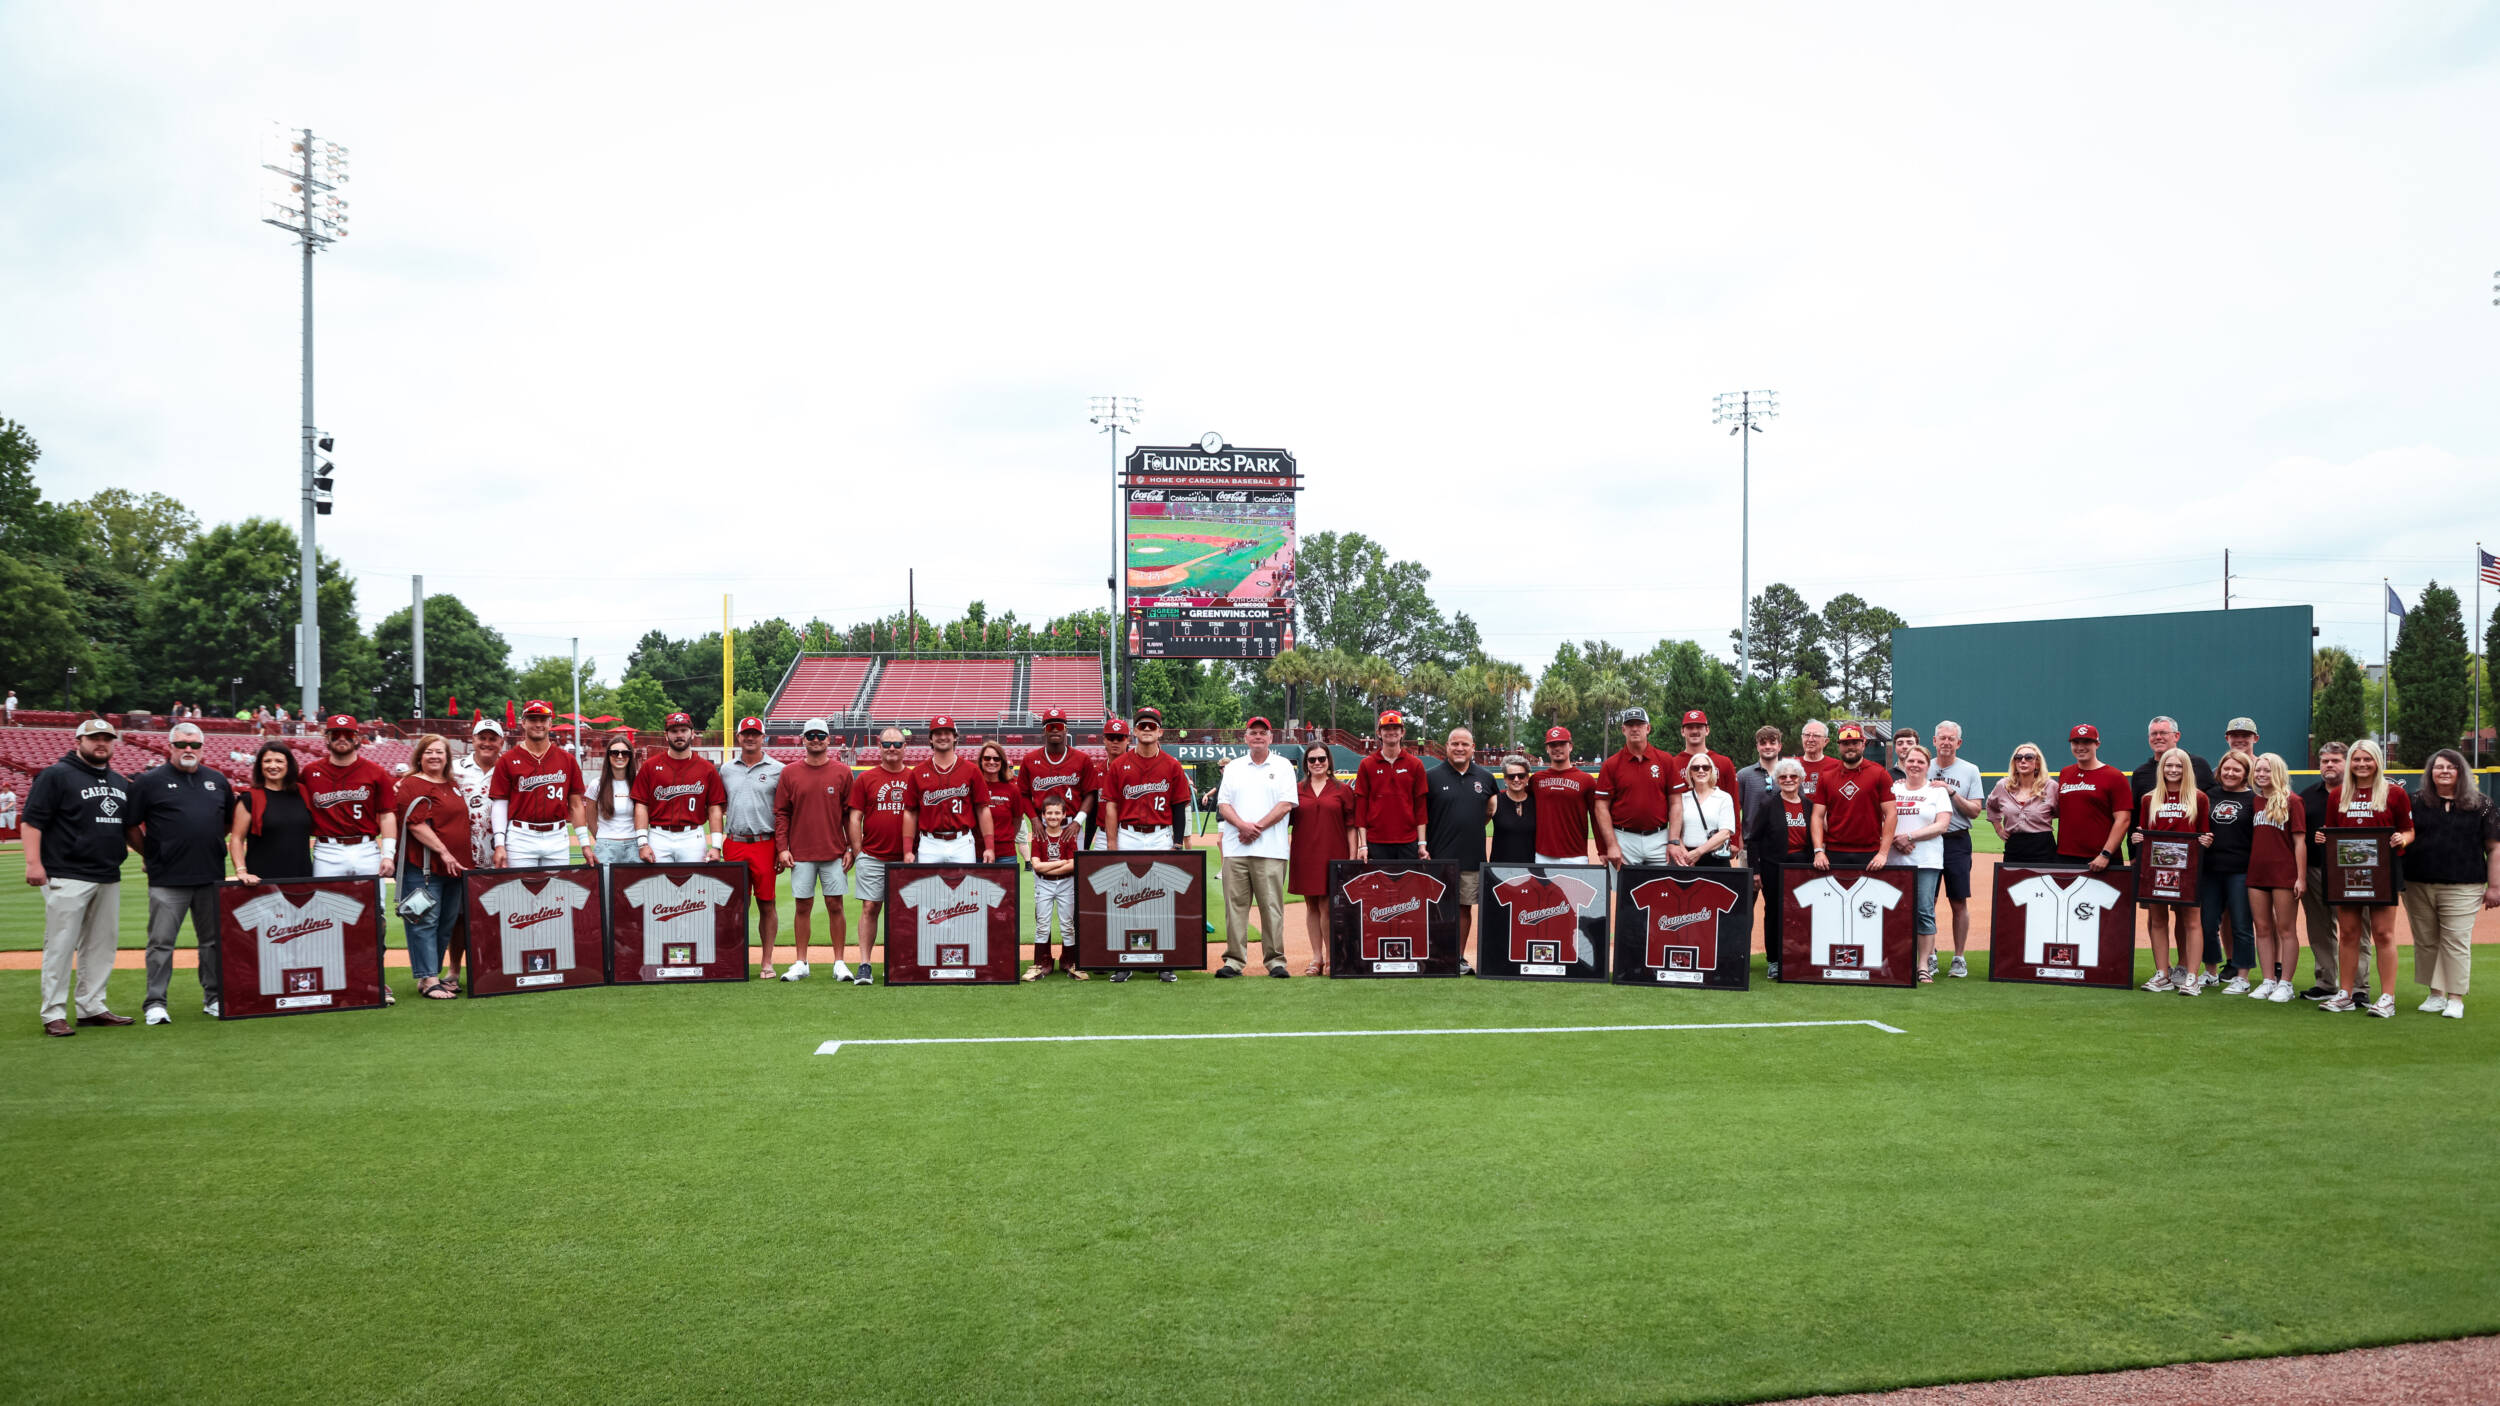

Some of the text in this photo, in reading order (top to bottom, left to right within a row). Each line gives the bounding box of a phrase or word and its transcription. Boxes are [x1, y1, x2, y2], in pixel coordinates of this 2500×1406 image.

[1143, 453, 1280, 472] FOUNDERS PARK
[1189, 609, 1270, 618] GREENWINS.COM
[1179, 746, 1237, 758] PRISMA
[547, 785, 564, 801] 34
[1065, 787, 1073, 800] 4
[353, 804, 363, 819] 5
[689, 797, 696, 811] 0
[952, 799, 962, 814] 21
[1154, 796, 1166, 811] 12
[1113, 887, 1166, 909] Carolina
[508, 906, 564, 930] Carolina
[652, 899, 707, 922] Carolina
[927, 900, 980, 925] Carolina
[1369, 896, 1420, 923] Gamecocks
[1518, 900, 1571, 926] Gamecocks
[1658, 906, 1712, 931] Gamecocks
[266, 918, 333, 944] Carolina
